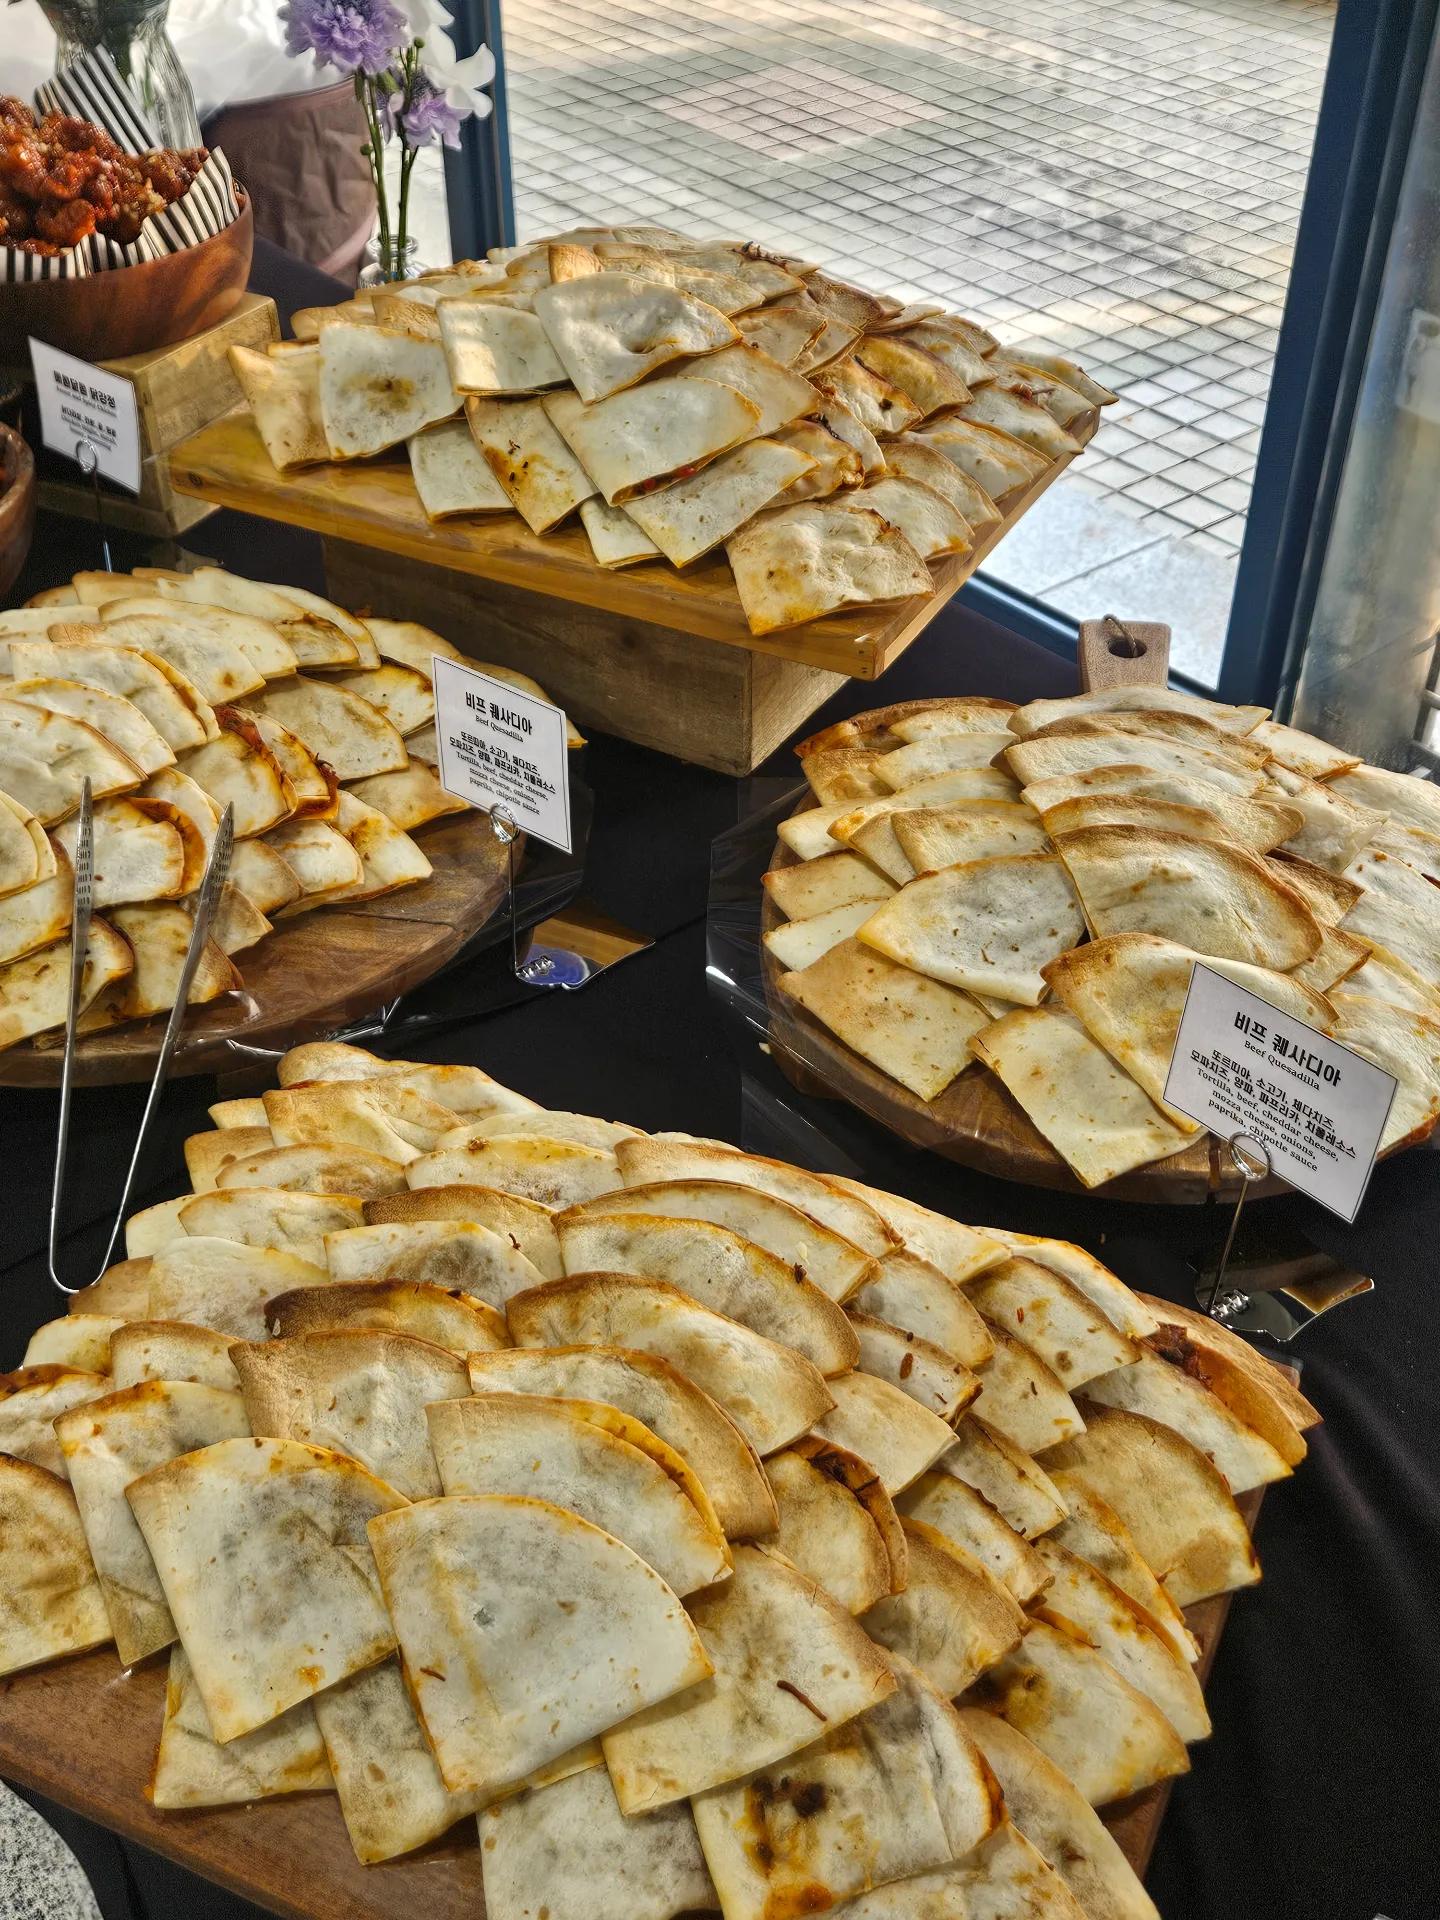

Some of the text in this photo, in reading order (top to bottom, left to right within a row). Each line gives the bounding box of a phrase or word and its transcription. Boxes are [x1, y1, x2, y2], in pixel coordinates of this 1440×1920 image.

[466, 691, 533, 736] 비프 퀘사디아
[475, 714, 524, 743] Beef Quesadilla
[489, 744, 511, 763] 소고기,
[1233, 1011, 1342, 1087] 비프 퀘사디아
[1244, 1040, 1320, 1091] Beef Quesadilla
[1197, 1067, 1339, 1162] Tortilla, beef, cheddar cheese,
[1208, 1099, 1318, 1172] paprika, chipotle sauce
[1212, 1089, 1316, 1160] mozza cheese, onions,
[1234, 1076, 1255, 1098] 양파,
[1258, 1091, 1301, 1126] 파프리카,
[1304, 1119, 1356, 1159] 치폴레소스
[1255, 1077, 1288, 1104] 소고기,
[1292, 1098, 1335, 1133] 체다치즈,
